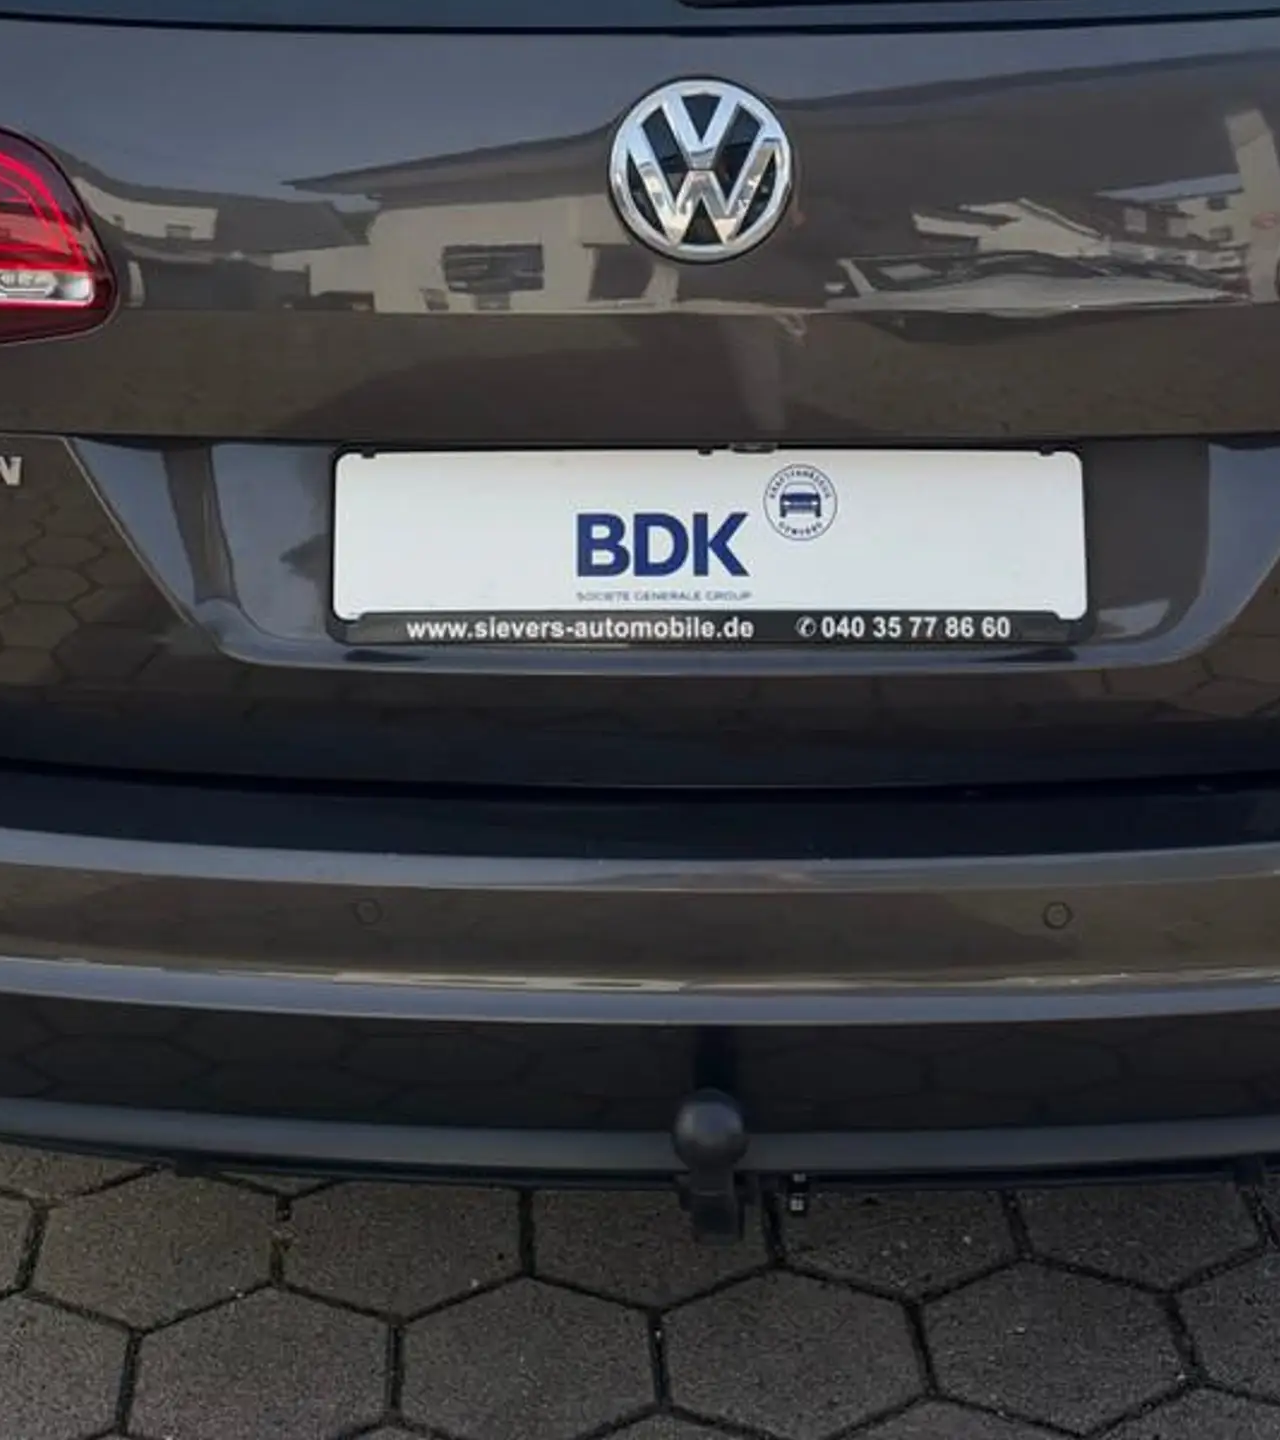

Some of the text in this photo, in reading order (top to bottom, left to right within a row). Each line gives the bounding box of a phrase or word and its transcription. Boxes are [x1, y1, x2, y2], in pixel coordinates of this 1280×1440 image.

[577, 512, 750, 577] BDK
[406, 615, 755, 640] www.sievers-automobile.de
[821, 615, 1011, 639] 040 35 77 86 60
